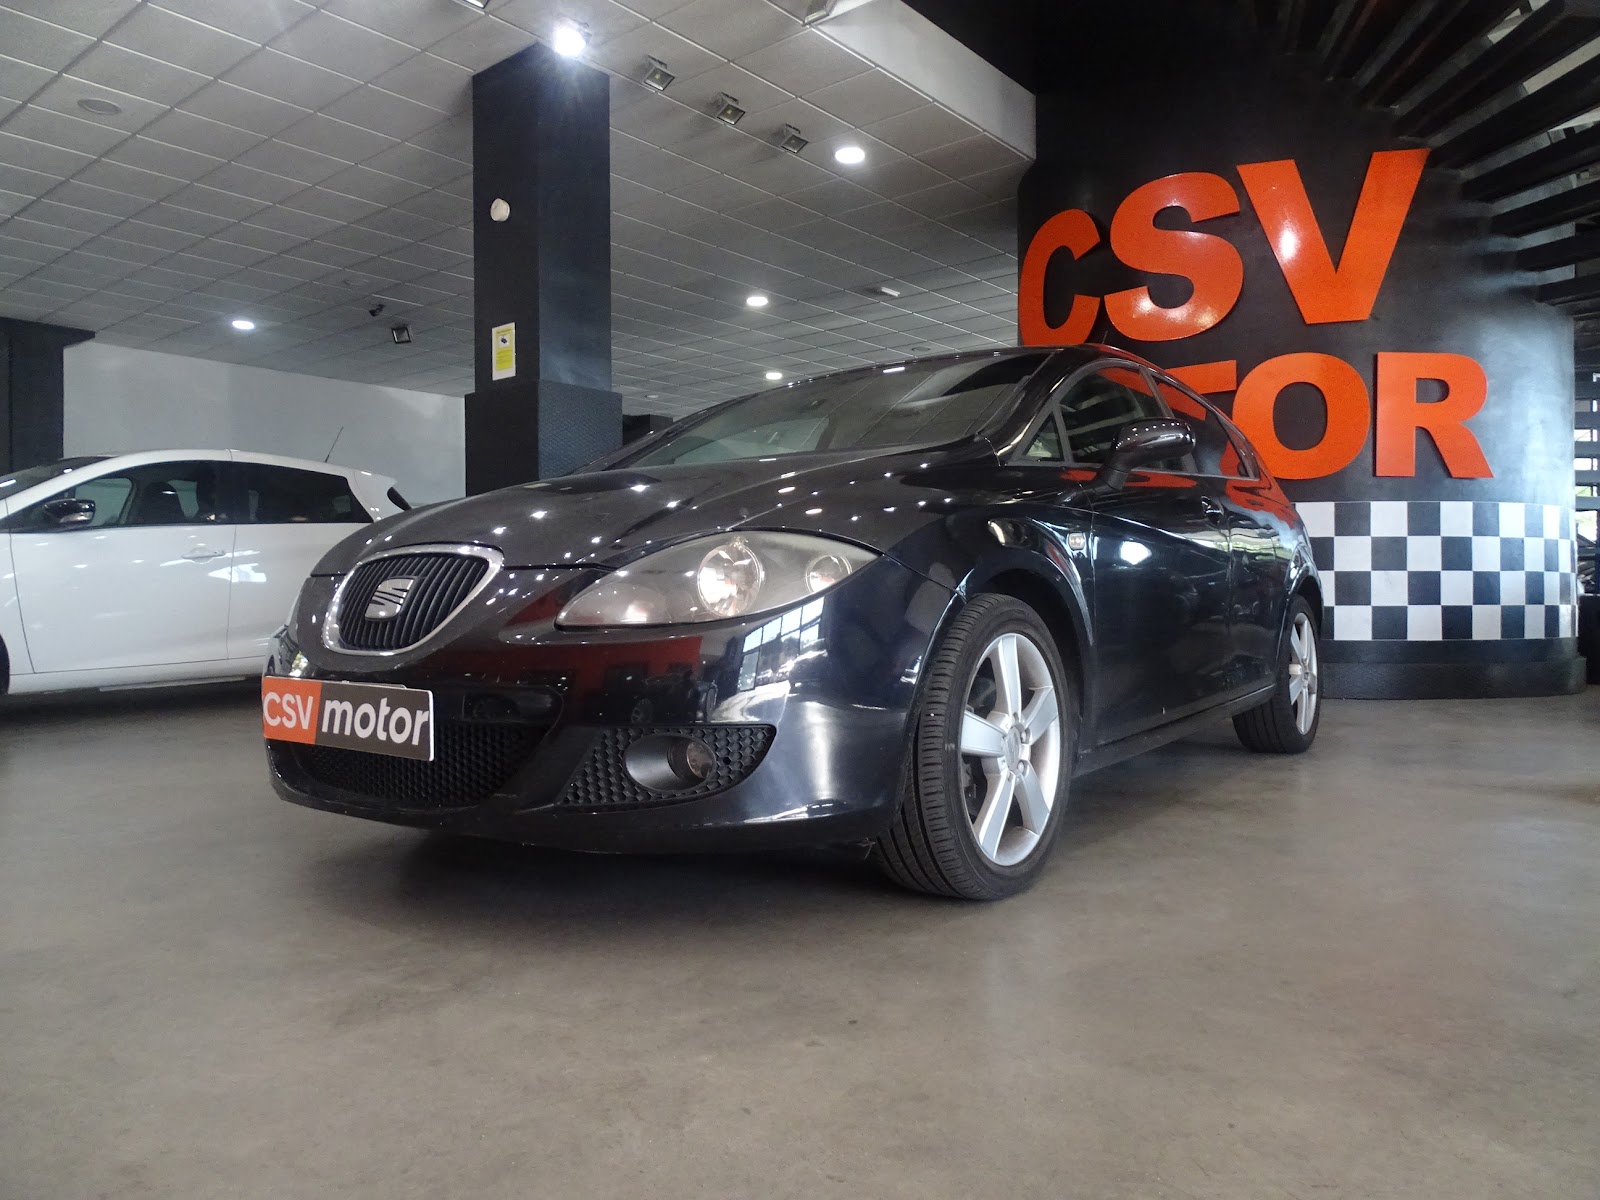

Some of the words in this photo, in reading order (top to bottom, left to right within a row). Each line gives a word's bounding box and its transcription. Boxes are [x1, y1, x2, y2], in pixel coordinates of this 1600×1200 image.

[1018, 148, 1430, 346] CSV
[1163, 352, 1494, 479] OR
[263, 691, 313, 730] CSV
[321, 697, 429, 746] motor
